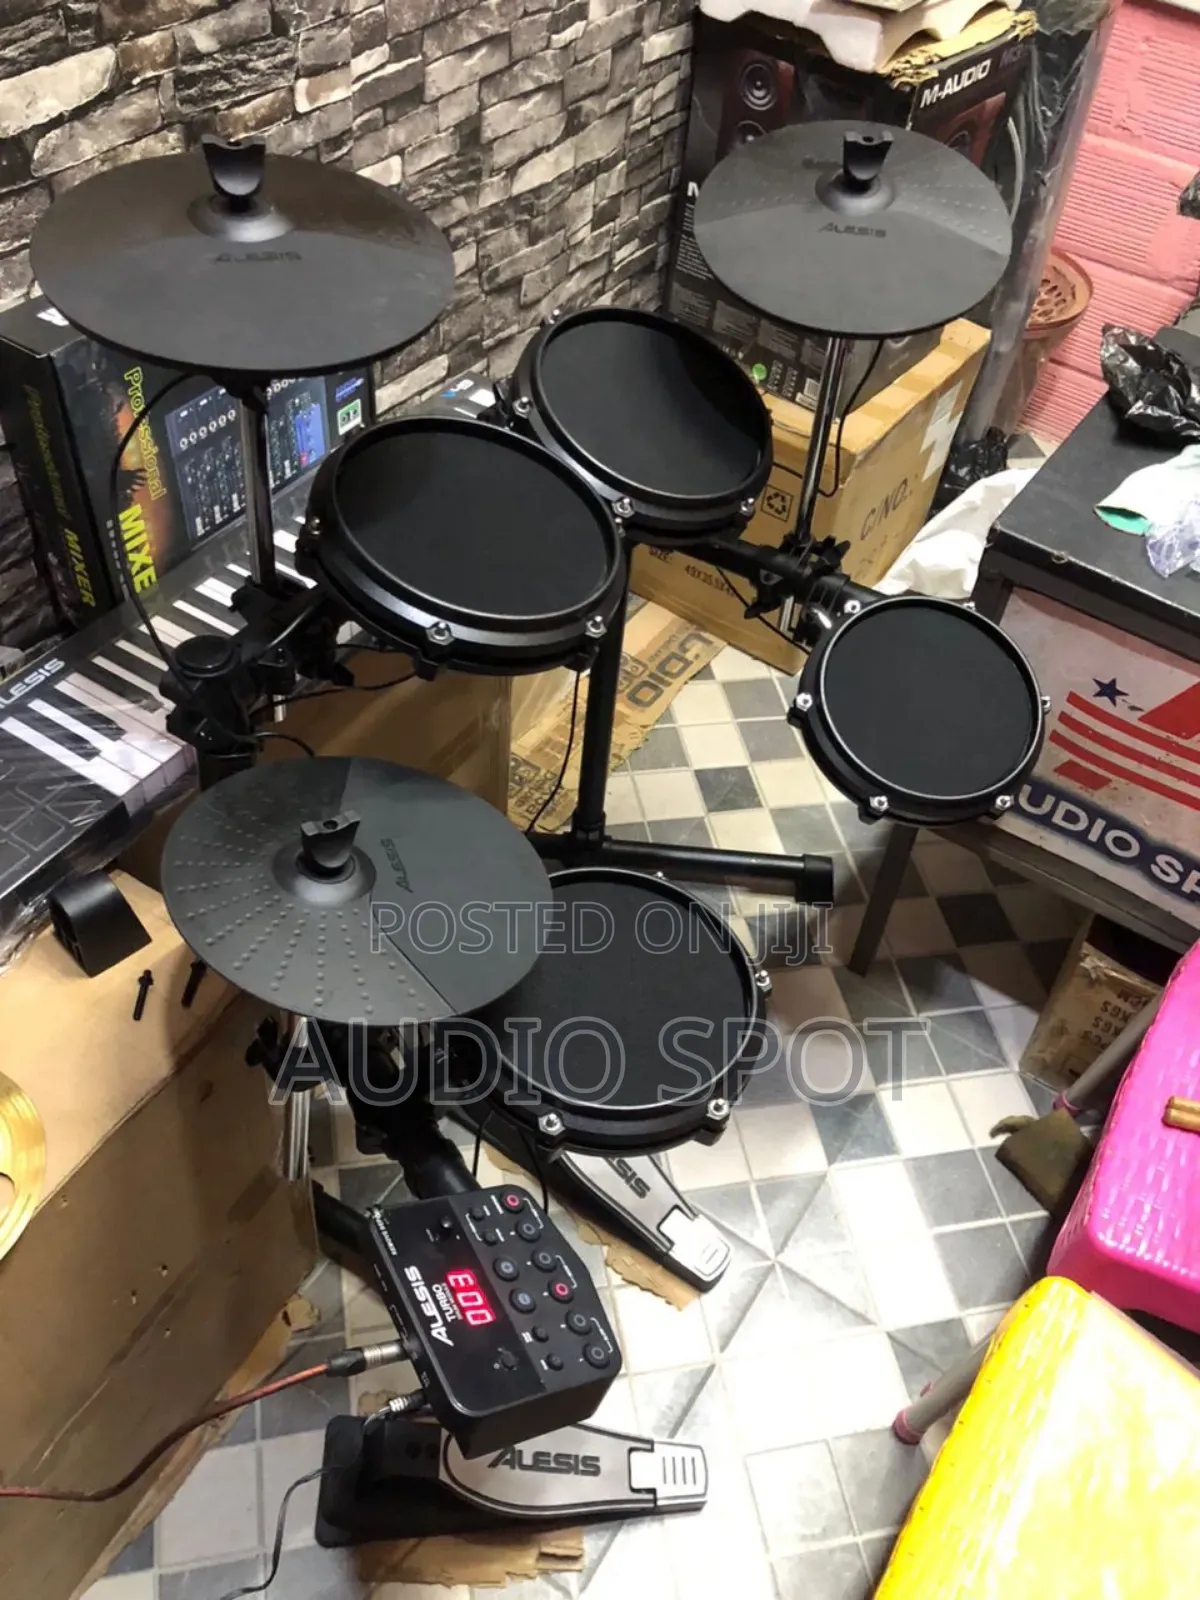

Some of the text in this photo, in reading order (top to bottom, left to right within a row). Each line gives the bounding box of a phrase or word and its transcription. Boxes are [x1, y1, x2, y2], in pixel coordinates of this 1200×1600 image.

[920, 58, 993, 108] M-AUDIO
[124, 366, 167, 501] Prossional
[64, 527, 96, 607] MIXER
[118, 503, 158, 593] MIXE
[0, 658, 65, 709] LESIS
[1018, 784, 1141, 859] UDIO
[404, 1265, 455, 1347] ALESIS
[431, 1284, 457, 1322] TURBO
[447, 1271, 494, 1326] 003
[487, 1445, 601, 1477] ALESIS
